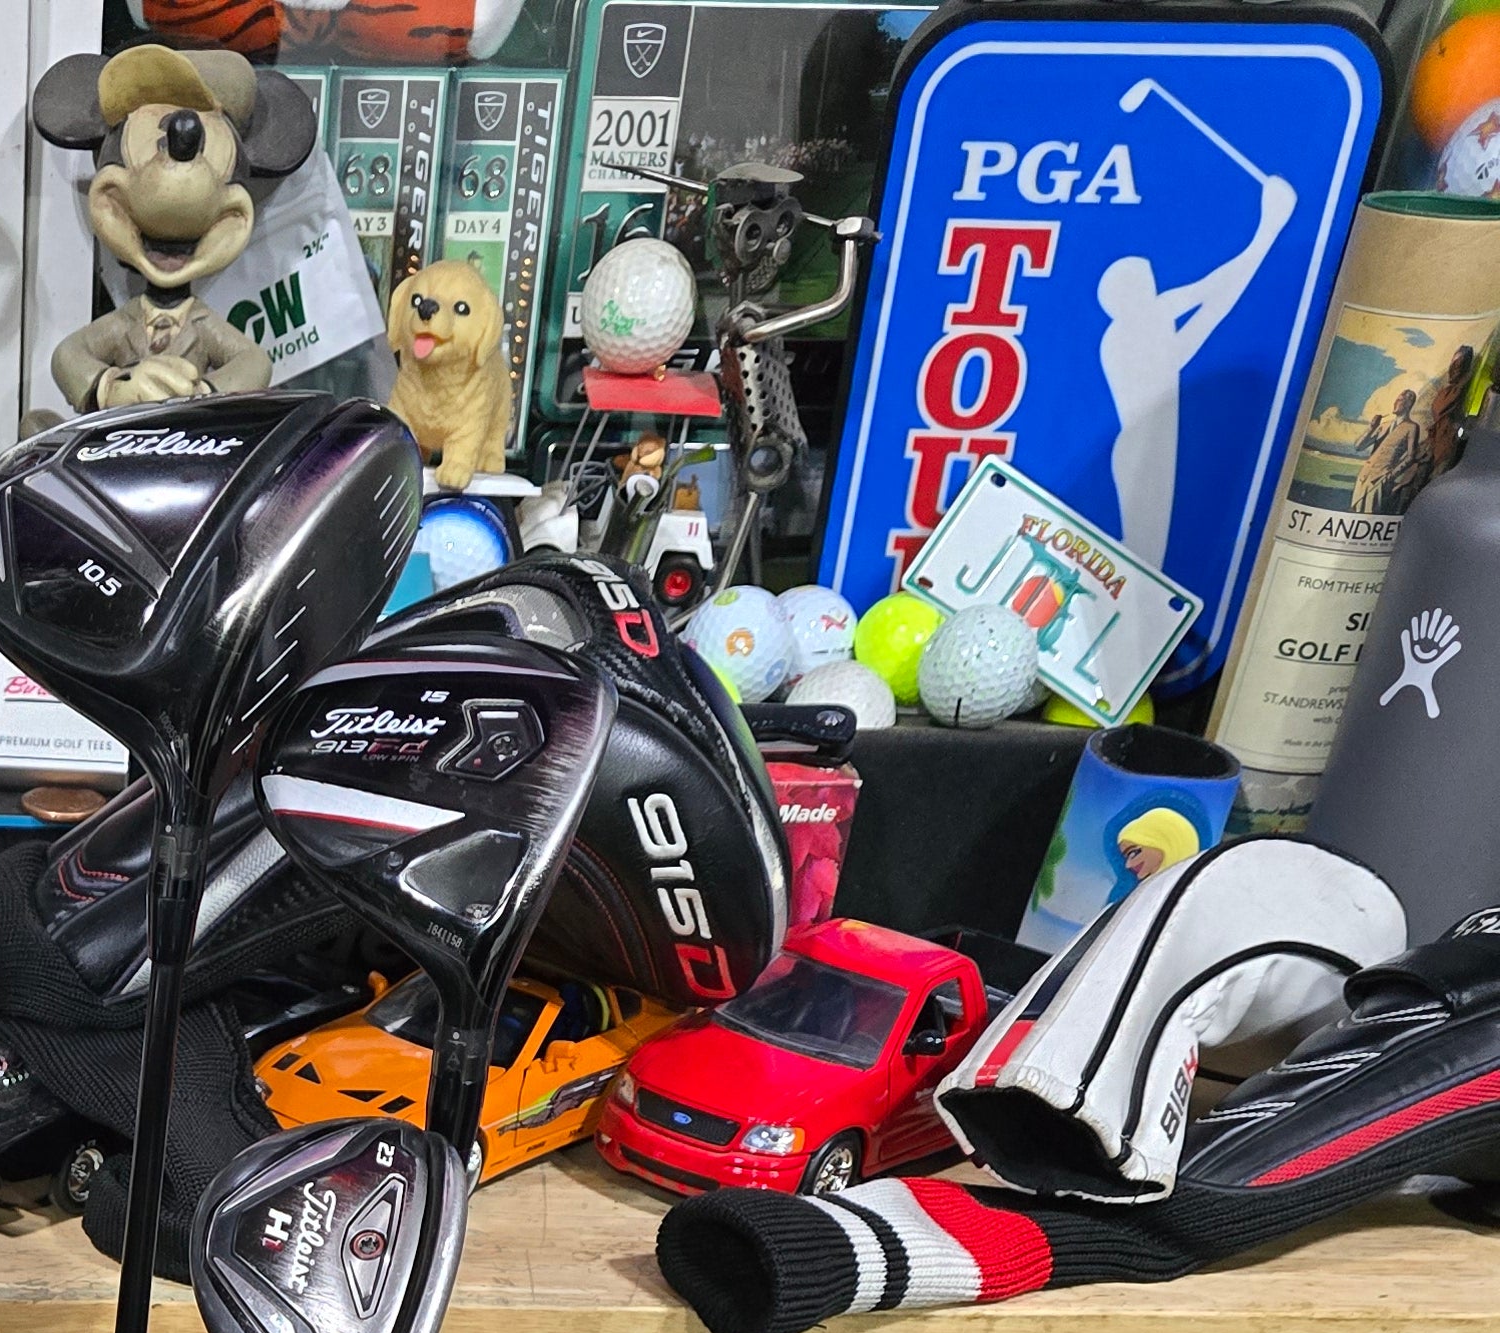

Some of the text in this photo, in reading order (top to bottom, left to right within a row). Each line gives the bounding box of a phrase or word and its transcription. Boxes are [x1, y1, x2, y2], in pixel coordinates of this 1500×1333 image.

[592, 109, 671, 148] 2001
[341, 154, 392, 196] 68
[589, 151, 668, 167] MASTERS
[953, 140, 1141, 205] PGA
[458, 155, 508, 200] 68
[522, 101, 552, 253] TIGER
[351, 215, 388, 231] AY 3
[454, 218, 500, 234] DAY 4
[267, 325, 320, 363] World
[77, 429, 245, 462] Titleist
[1288, 510, 1402, 542] ST. ANDRE
[1018, 513, 1128, 600] FLORIDA
[77, 558, 124, 597] 10.5
[1298, 576, 1383, 594] FROM THE HO
[1278, 638, 1350, 663] GOLF
[421, 690, 449, 703] 15
[311, 705, 447, 740] Titleist
[0, 735, 113, 752] PREMIUM GOLF TEES
[362, 754, 420, 763] LOW SPIN
[779, 804, 837, 824] Made
[628, 793, 736, 999] 915D
[376, 1141, 395, 1167] 23
[289, 1182, 338, 1292] Titleist
